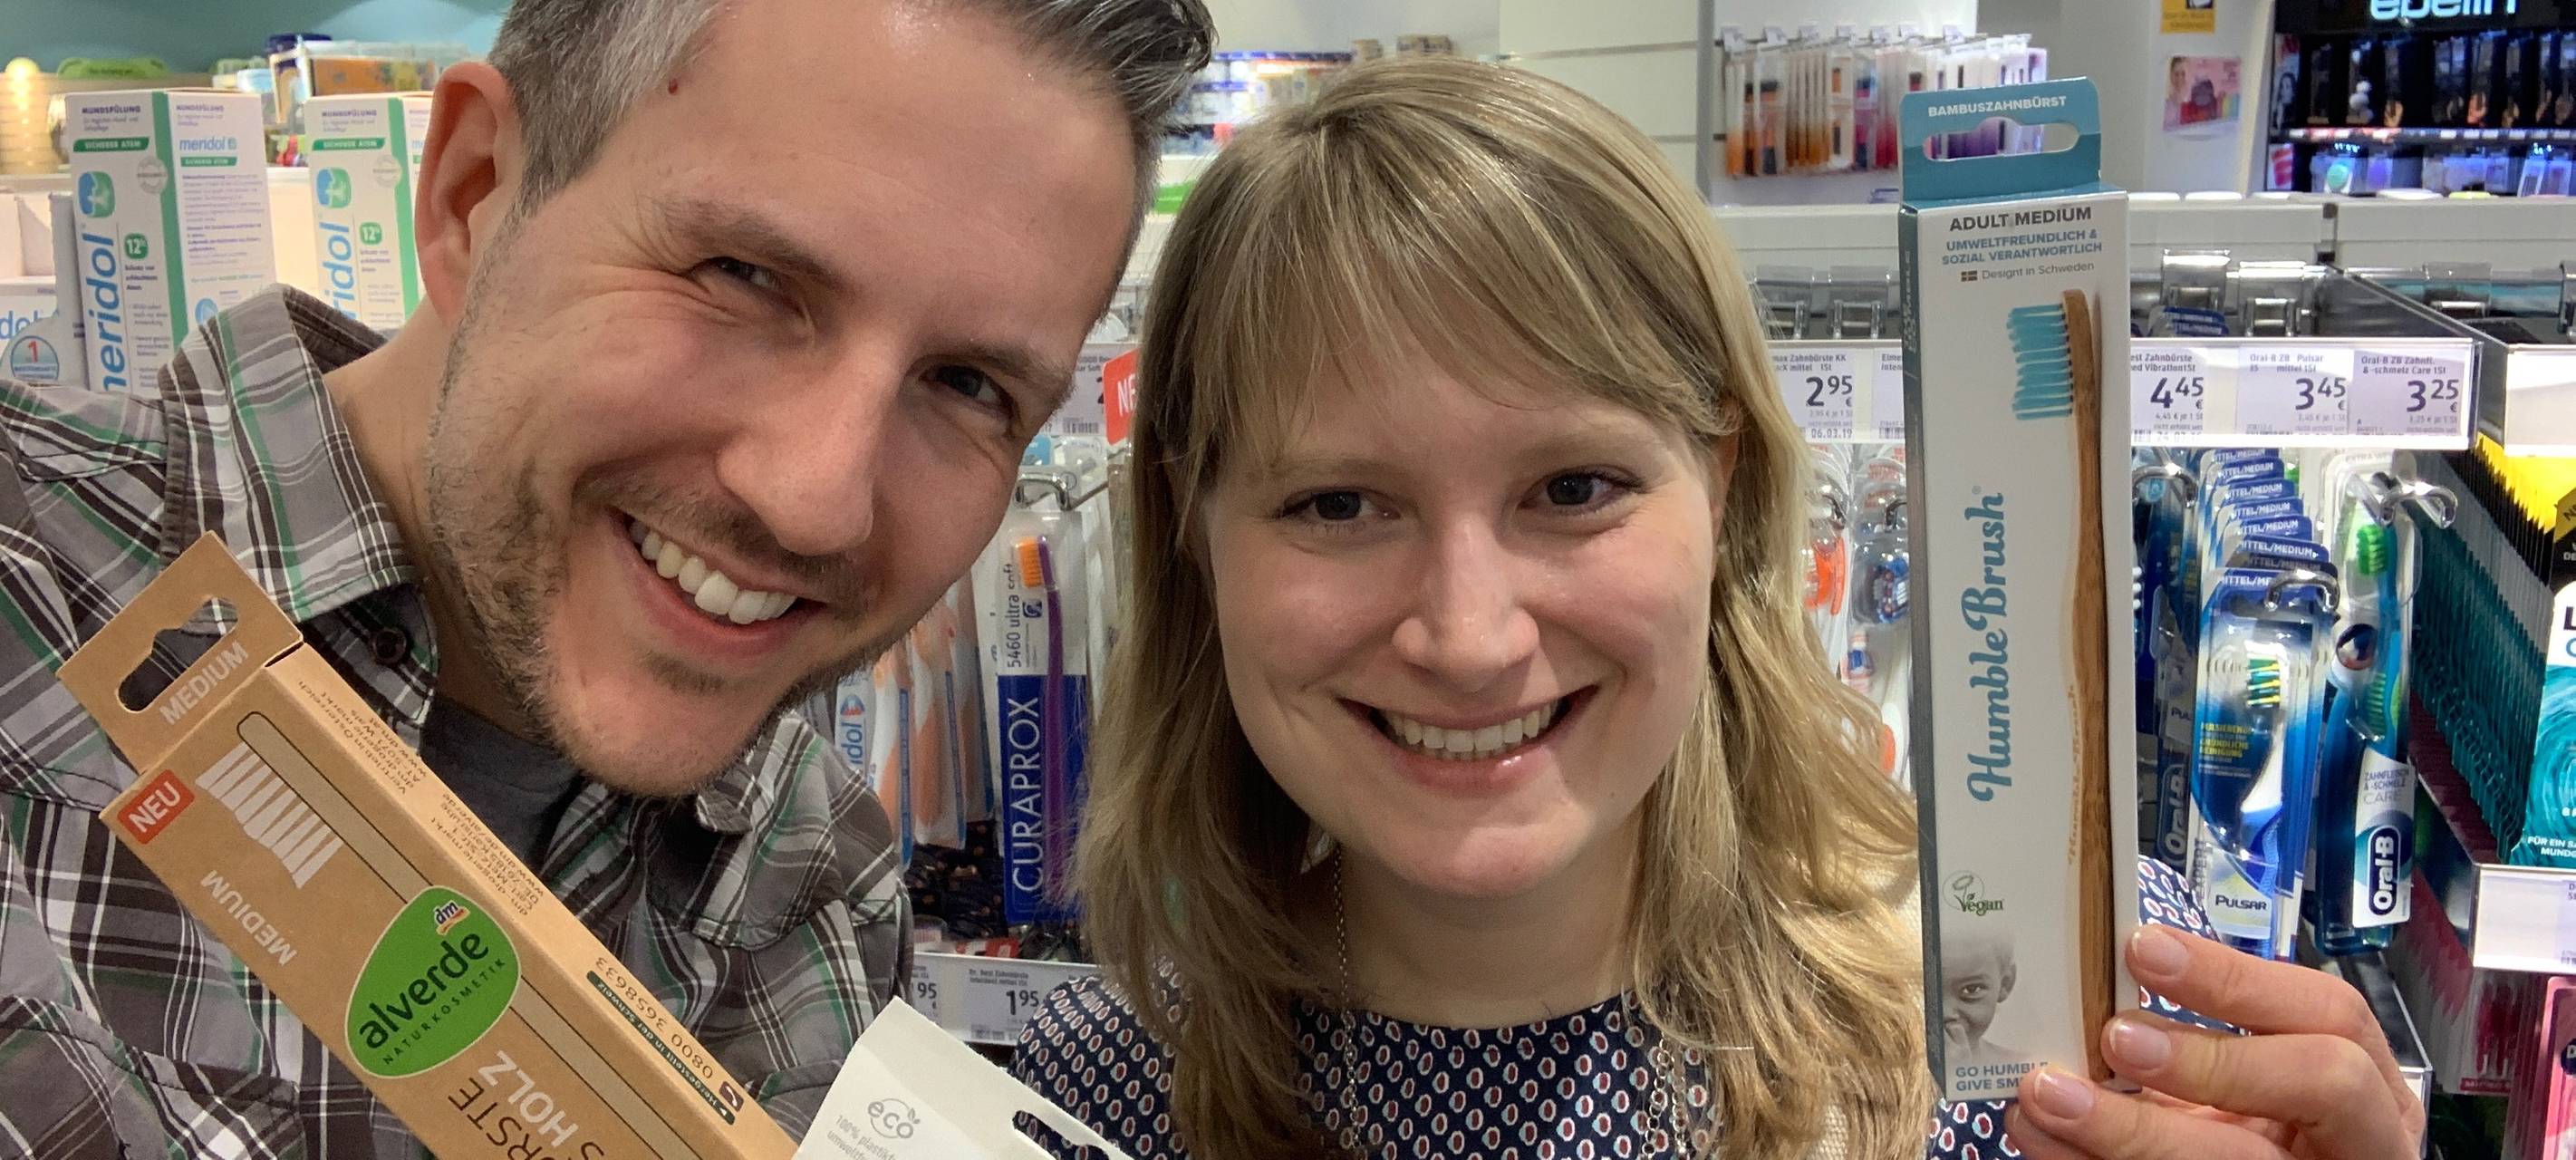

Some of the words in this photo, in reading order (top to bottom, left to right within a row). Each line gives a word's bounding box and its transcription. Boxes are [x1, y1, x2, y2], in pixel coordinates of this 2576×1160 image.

[1927, 95, 2067, 117] BAMBUSZAHNBÜRST
[1949, 214, 2010, 232] ADULT
[2015, 207, 2092, 227] MEDIUM
[1942, 252, 1985, 266] SOZIAL
[1989, 242, 2102, 262] VERANTWORTLICH
[1946, 230, 2086, 252] UMWELTFREUNDLICH
[2089, 228, 2098, 239] &
[1982, 267, 2023, 282] Designt
[2025, 266, 2035, 276] in
[2038, 262, 2095, 276] Schweden
[1790, 353, 1834, 363] Zahnbürste
[1835, 353, 1847, 362] KK
[2145, 353, 2193, 362] Zahnbürste
[1005, 594, 1021, 628] ultra
[1006, 632, 1021, 668] 5460
[159, 642, 249, 726] MEDIUM
[295, 679, 353, 740] Österreich
[363, 749, 408, 795] Vertrieb
[127, 778, 182, 835] NEU
[1007, 696, 1044, 893] CURAPROX
[2363, 791, 2402, 805] CARE
[2527, 836, 2548, 846] FÜR
[2550, 837, 2566, 847] EIN
[2372, 836, 2394, 911] Oral-B
[198, 865, 298, 968] MEDIUM
[435, 902, 460, 926] dm
[359, 931, 490, 1049] alverde
[593, 954, 668, 1031] 3658633
[916, 982, 938, 1000] 95
[381, 958, 507, 1066] NATURKOSMETIK
[668, 1030, 715, 1079] 0800
[1955, 1066, 1980, 1078] GO
[1956, 1079, 1992, 1092] GIVE
[1996, 1078, 2021, 1089] SM
[478, 1049, 580, 1147] HOLZ
